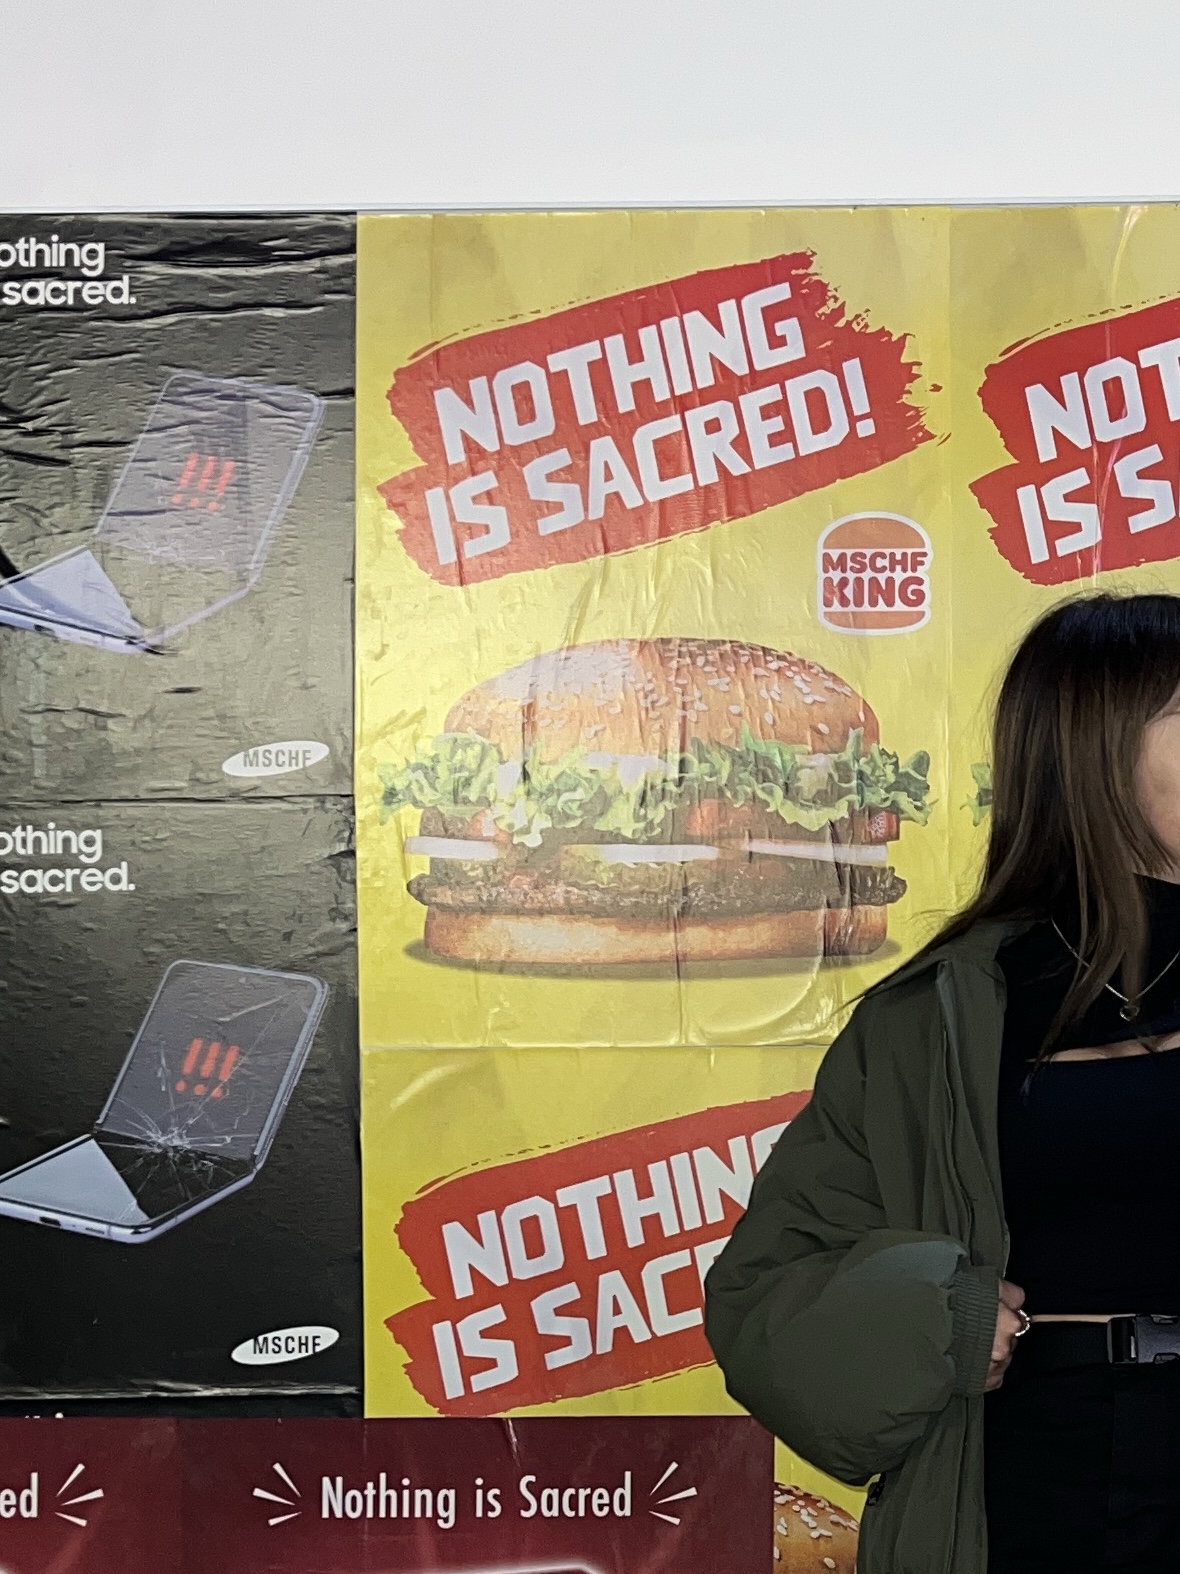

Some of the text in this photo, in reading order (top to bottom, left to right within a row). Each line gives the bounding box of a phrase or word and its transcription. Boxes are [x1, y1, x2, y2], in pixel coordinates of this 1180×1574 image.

[2, 275, 137, 305] sacred.
[434, 283, 806, 465] NOTHING
[425, 358, 876, 565] IS SACRED!
[1017, 468, 1102, 563] IS
[822, 551, 928, 574] MSCHF
[823, 576, 926, 608] KING
[243, 749, 312, 769] MSCHF
[0, 861, 136, 893] sacred.
[433, 1236, 733, 1400] IS SAC
[253, 1335, 322, 1355] MSCHF
[321, 1470, 632, 1529] Nothing is Sacred
